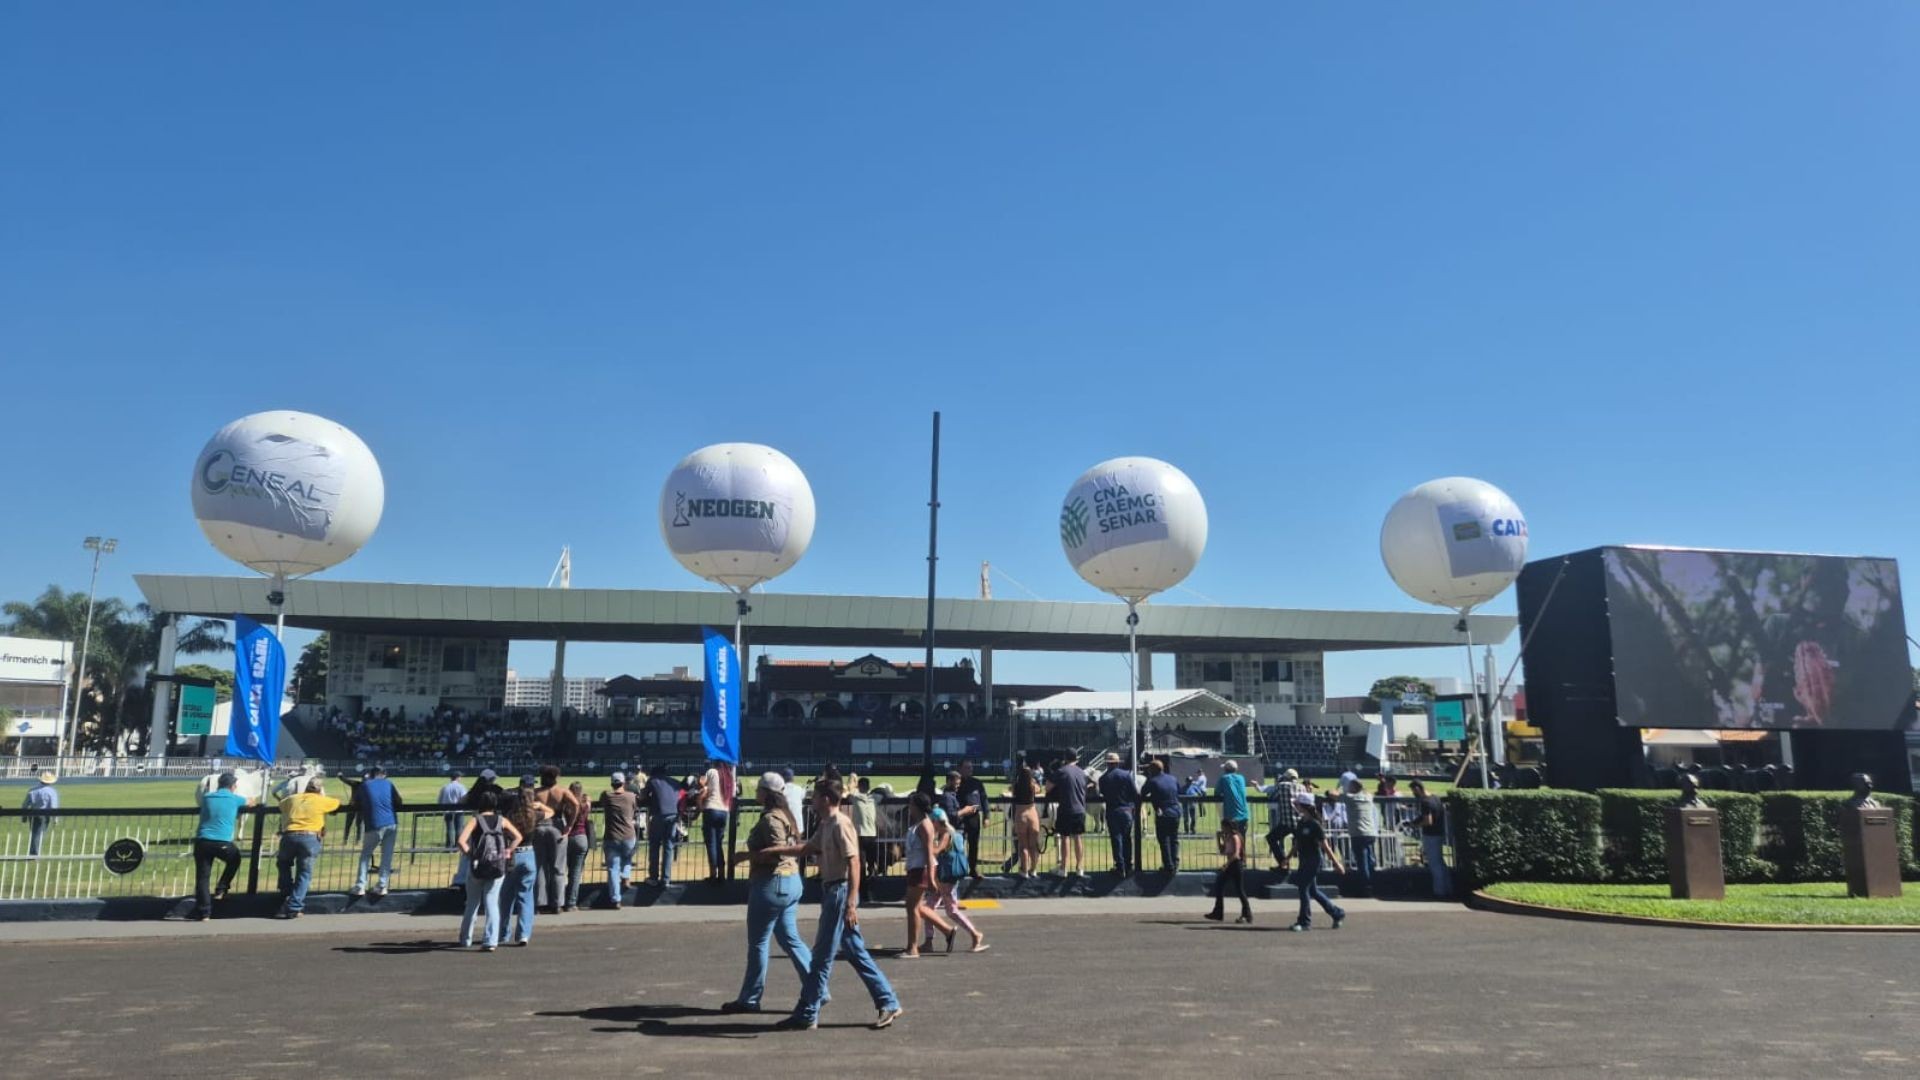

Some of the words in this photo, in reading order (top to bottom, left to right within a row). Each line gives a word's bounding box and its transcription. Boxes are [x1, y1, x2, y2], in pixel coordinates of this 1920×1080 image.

[1094, 485, 1129, 503] CNA
[1096, 494, 1156, 518] FAEMG
[687, 499, 775, 520] NEOGEN
[1099, 509, 1157, 533] SENAR
[252, 637, 269, 679] BRASIL
[249, 684, 263, 727] CAIXA
[718, 688, 727, 730] CAIXA
